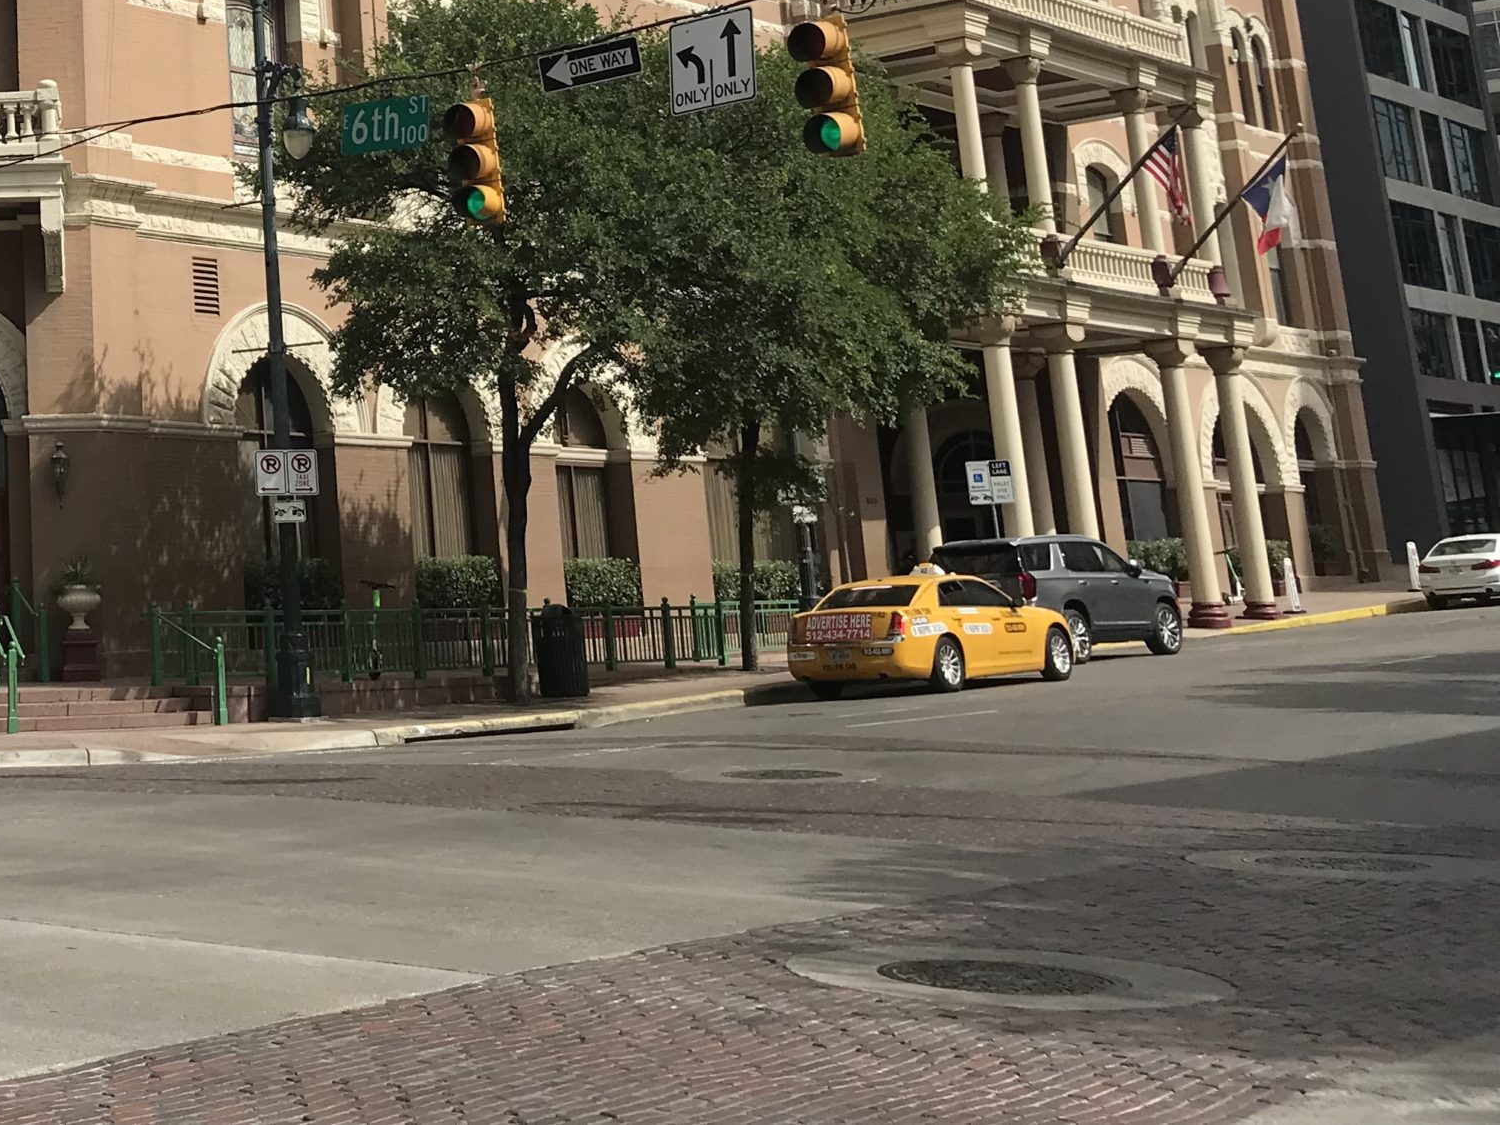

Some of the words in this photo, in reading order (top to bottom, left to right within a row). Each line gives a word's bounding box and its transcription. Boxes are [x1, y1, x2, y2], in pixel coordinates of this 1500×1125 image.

[569, 57, 596, 75] ONE
[600, 49, 628, 69] WAY
[675, 86, 710, 107] ONLY
[715, 78, 750, 98] ONLY
[343, 114, 349, 130] E
[351, 105, 399, 145] 6th
[408, 95, 428, 114] ST
[401, 124, 427, 145] 100
[806, 615, 848, 630] ADVERTISE
[850, 614, 871, 628] HERE
[806, 628, 870, 641] 512-434-7714
